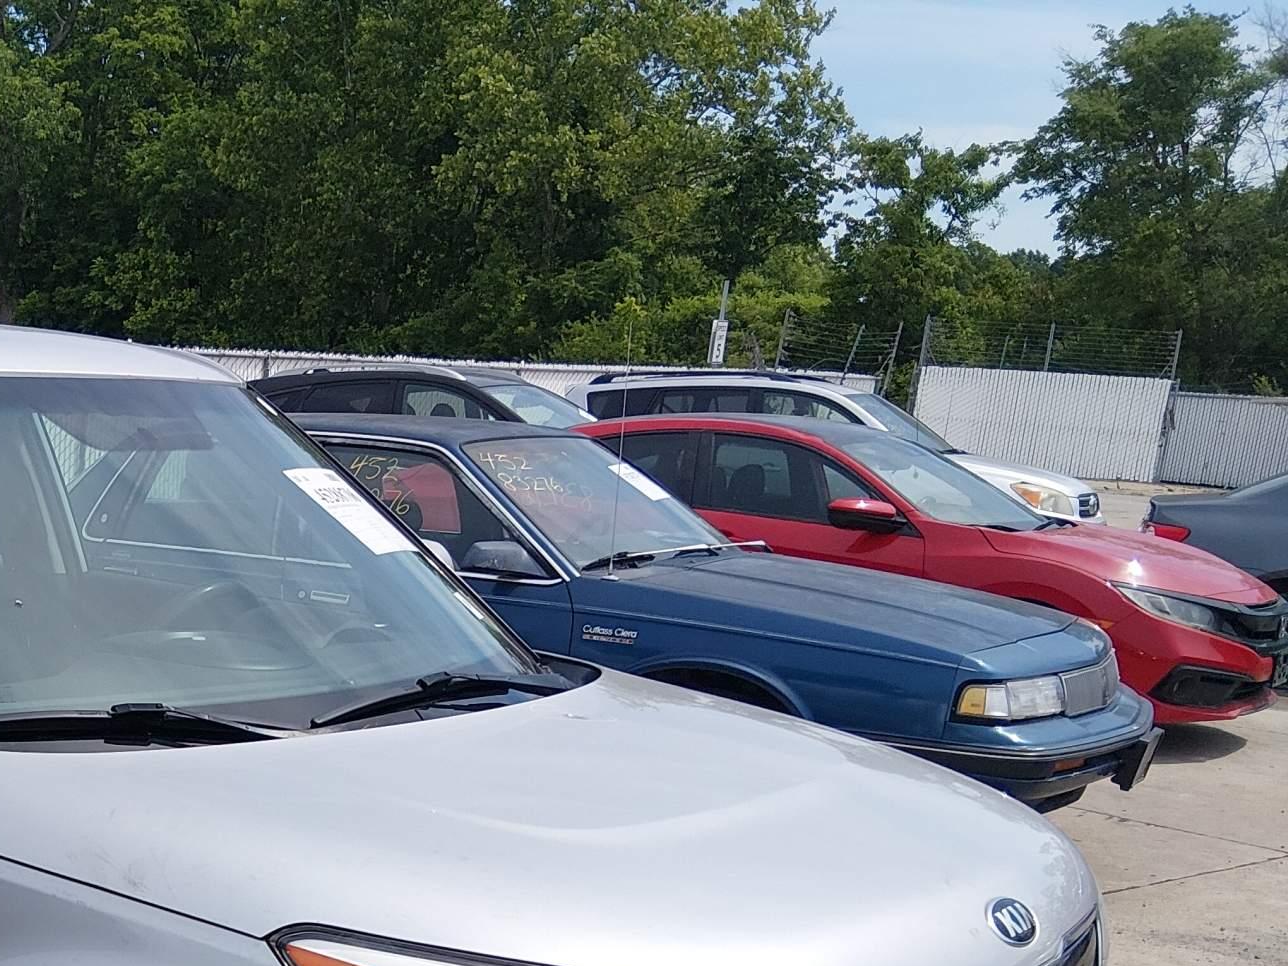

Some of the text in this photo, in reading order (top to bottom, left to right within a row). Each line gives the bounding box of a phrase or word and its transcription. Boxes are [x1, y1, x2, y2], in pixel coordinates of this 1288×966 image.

[715, 343, 722, 358] 5
[350, 455, 409, 482] 452
[479, 452, 534, 471] 452
[497, 472, 564, 492] 83276
[582, 624, 638, 638] Cutlass Ciera
[993, 902, 1034, 938] KIA
